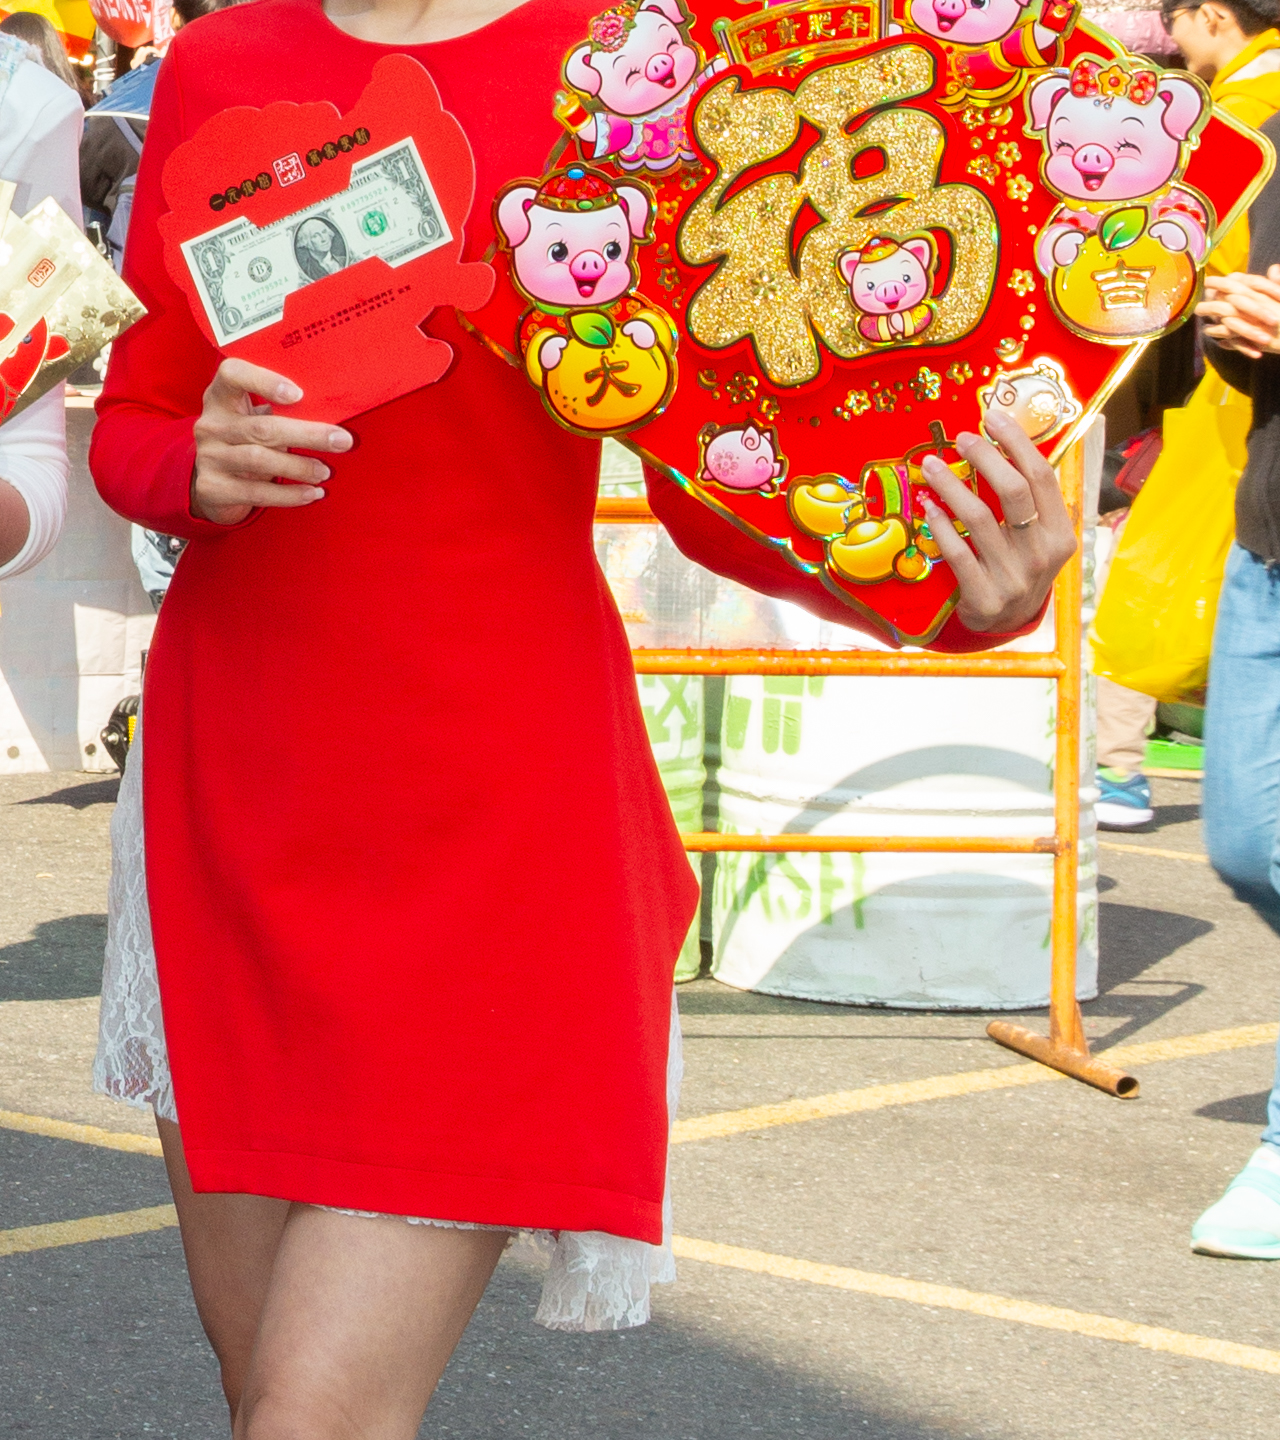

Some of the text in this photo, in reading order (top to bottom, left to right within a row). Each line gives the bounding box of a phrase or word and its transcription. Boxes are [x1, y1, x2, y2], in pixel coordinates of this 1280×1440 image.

[678, 42, 999, 388] 福
[1090, 261, 1153, 311] 吉
[585, 358, 642, 407] 大
